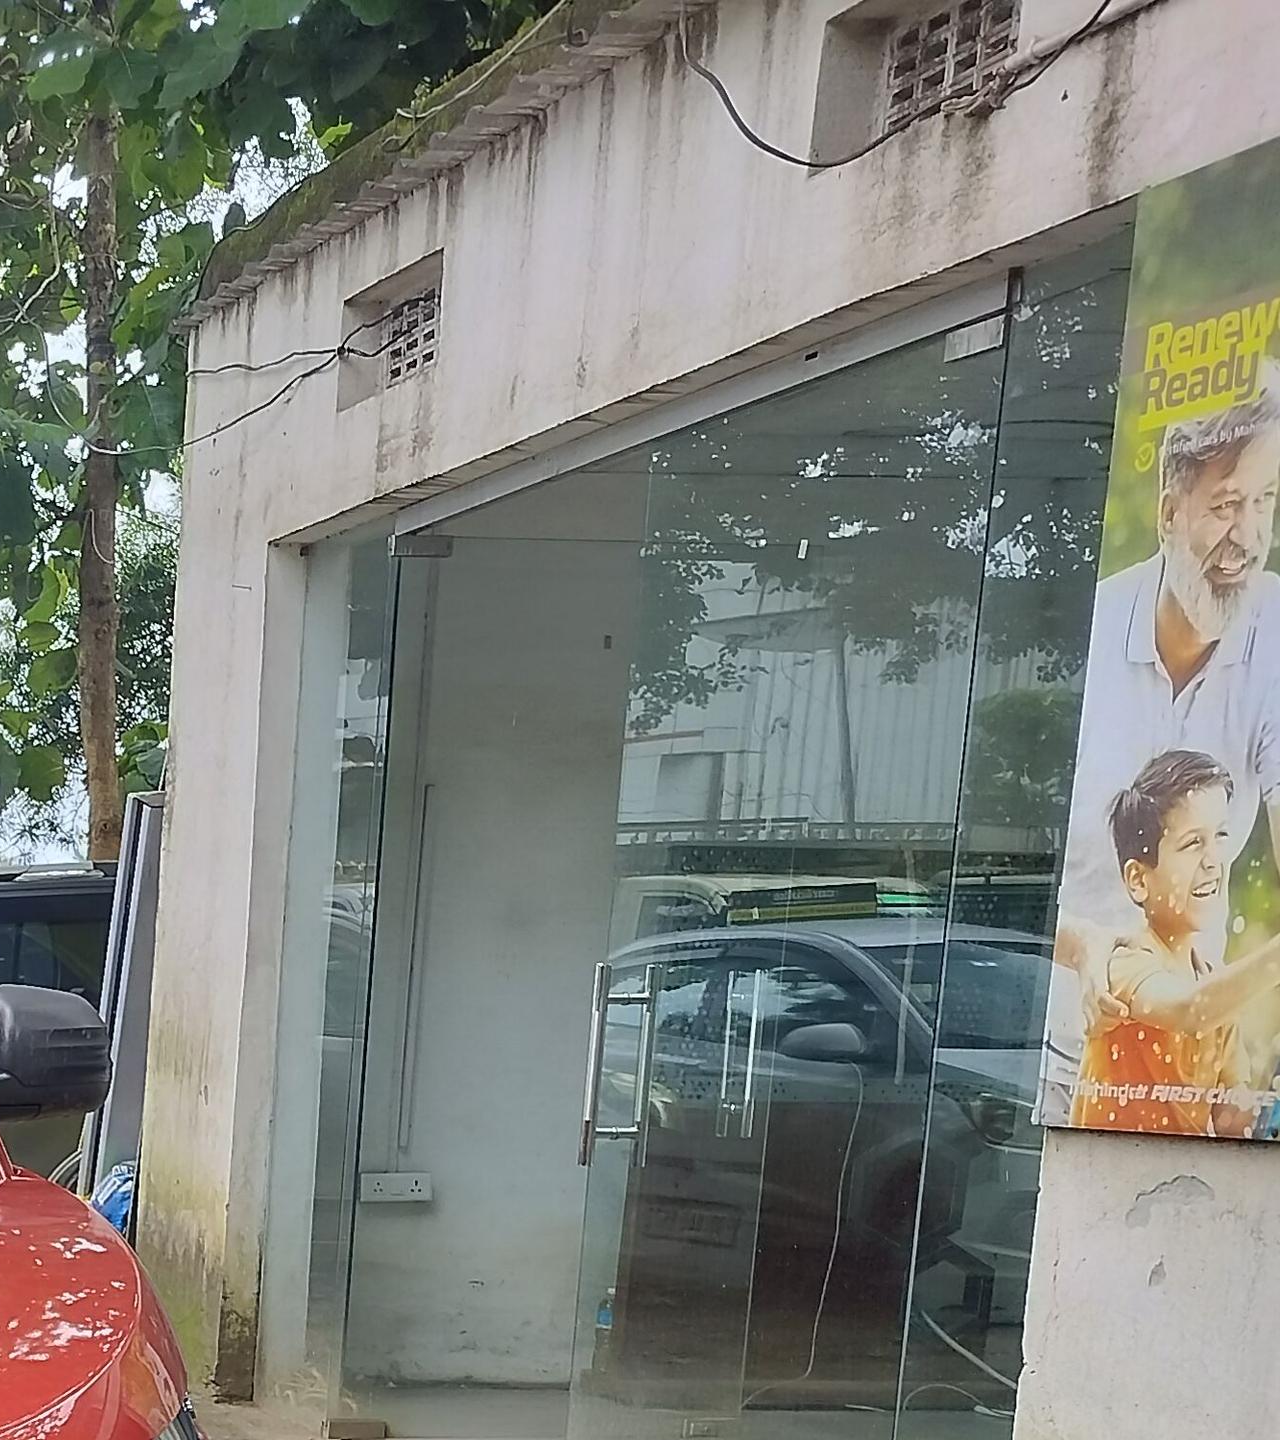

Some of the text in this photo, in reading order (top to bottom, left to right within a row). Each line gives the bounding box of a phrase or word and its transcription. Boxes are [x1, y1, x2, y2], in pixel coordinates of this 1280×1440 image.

[1145, 297, 1280, 371] Renew
[1140, 343, 1260, 416] Ready
[1150, 1084, 1206, 1103] FIRST
